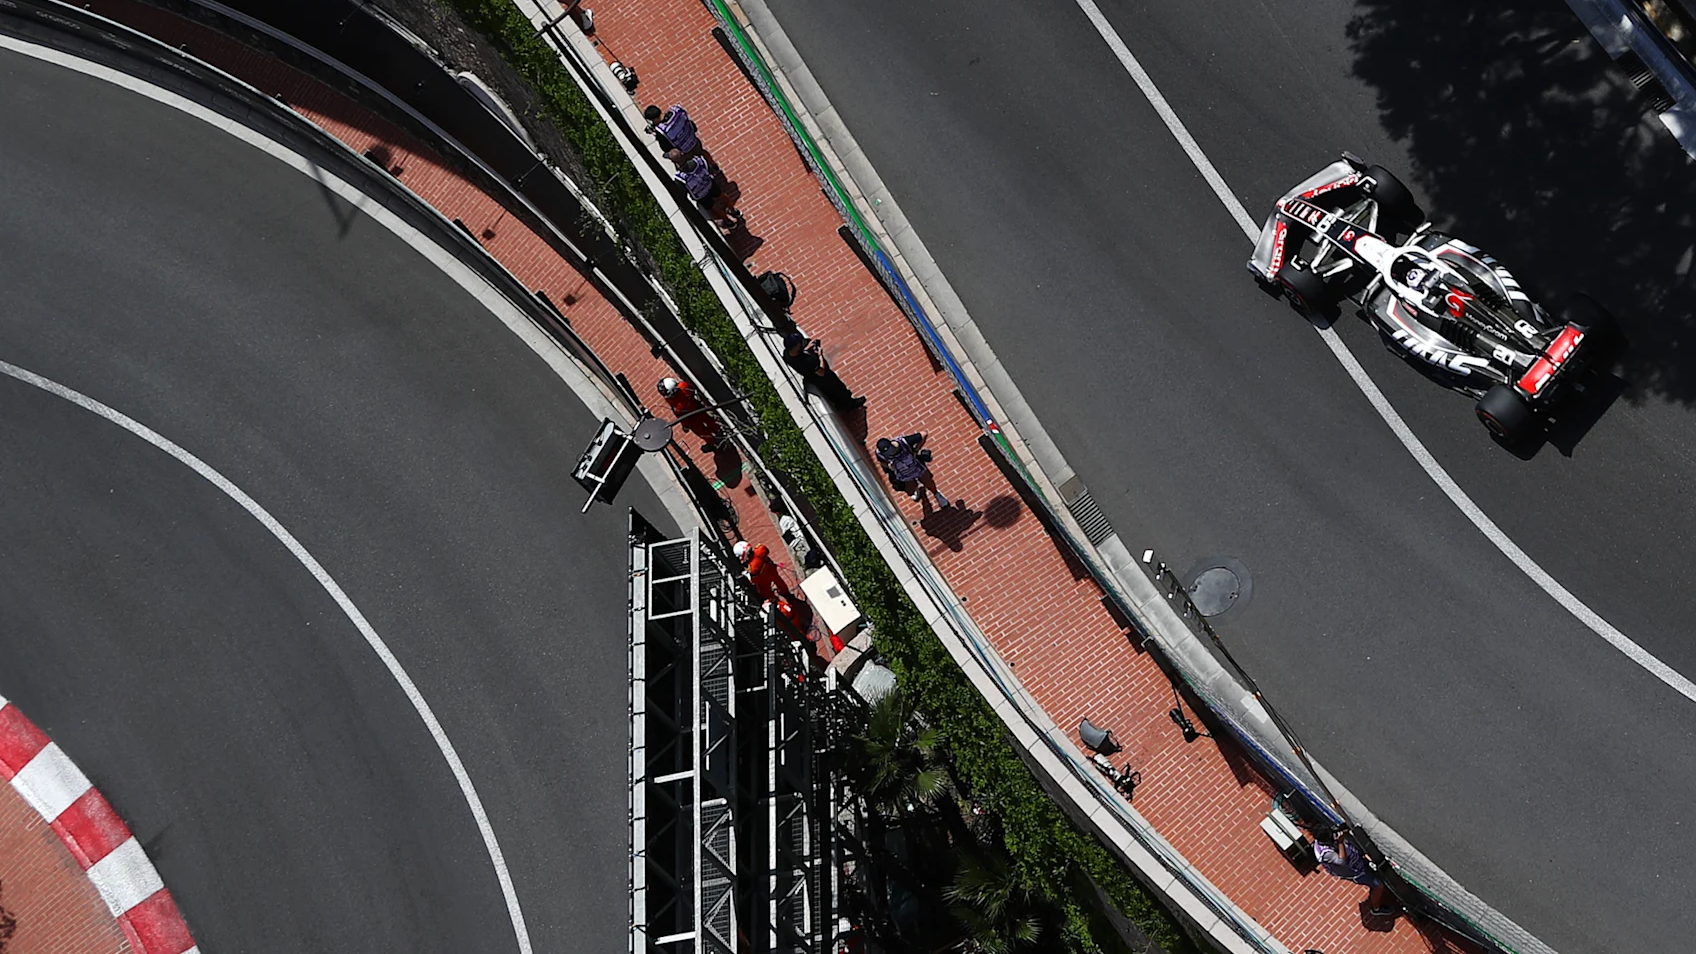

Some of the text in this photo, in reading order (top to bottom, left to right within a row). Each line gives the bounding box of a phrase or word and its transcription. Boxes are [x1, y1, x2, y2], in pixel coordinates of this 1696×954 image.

[1464, 311, 1508, 342] MoneyGram
[1513, 318, 1539, 339] 20
[1492, 344, 1517, 366] 20
